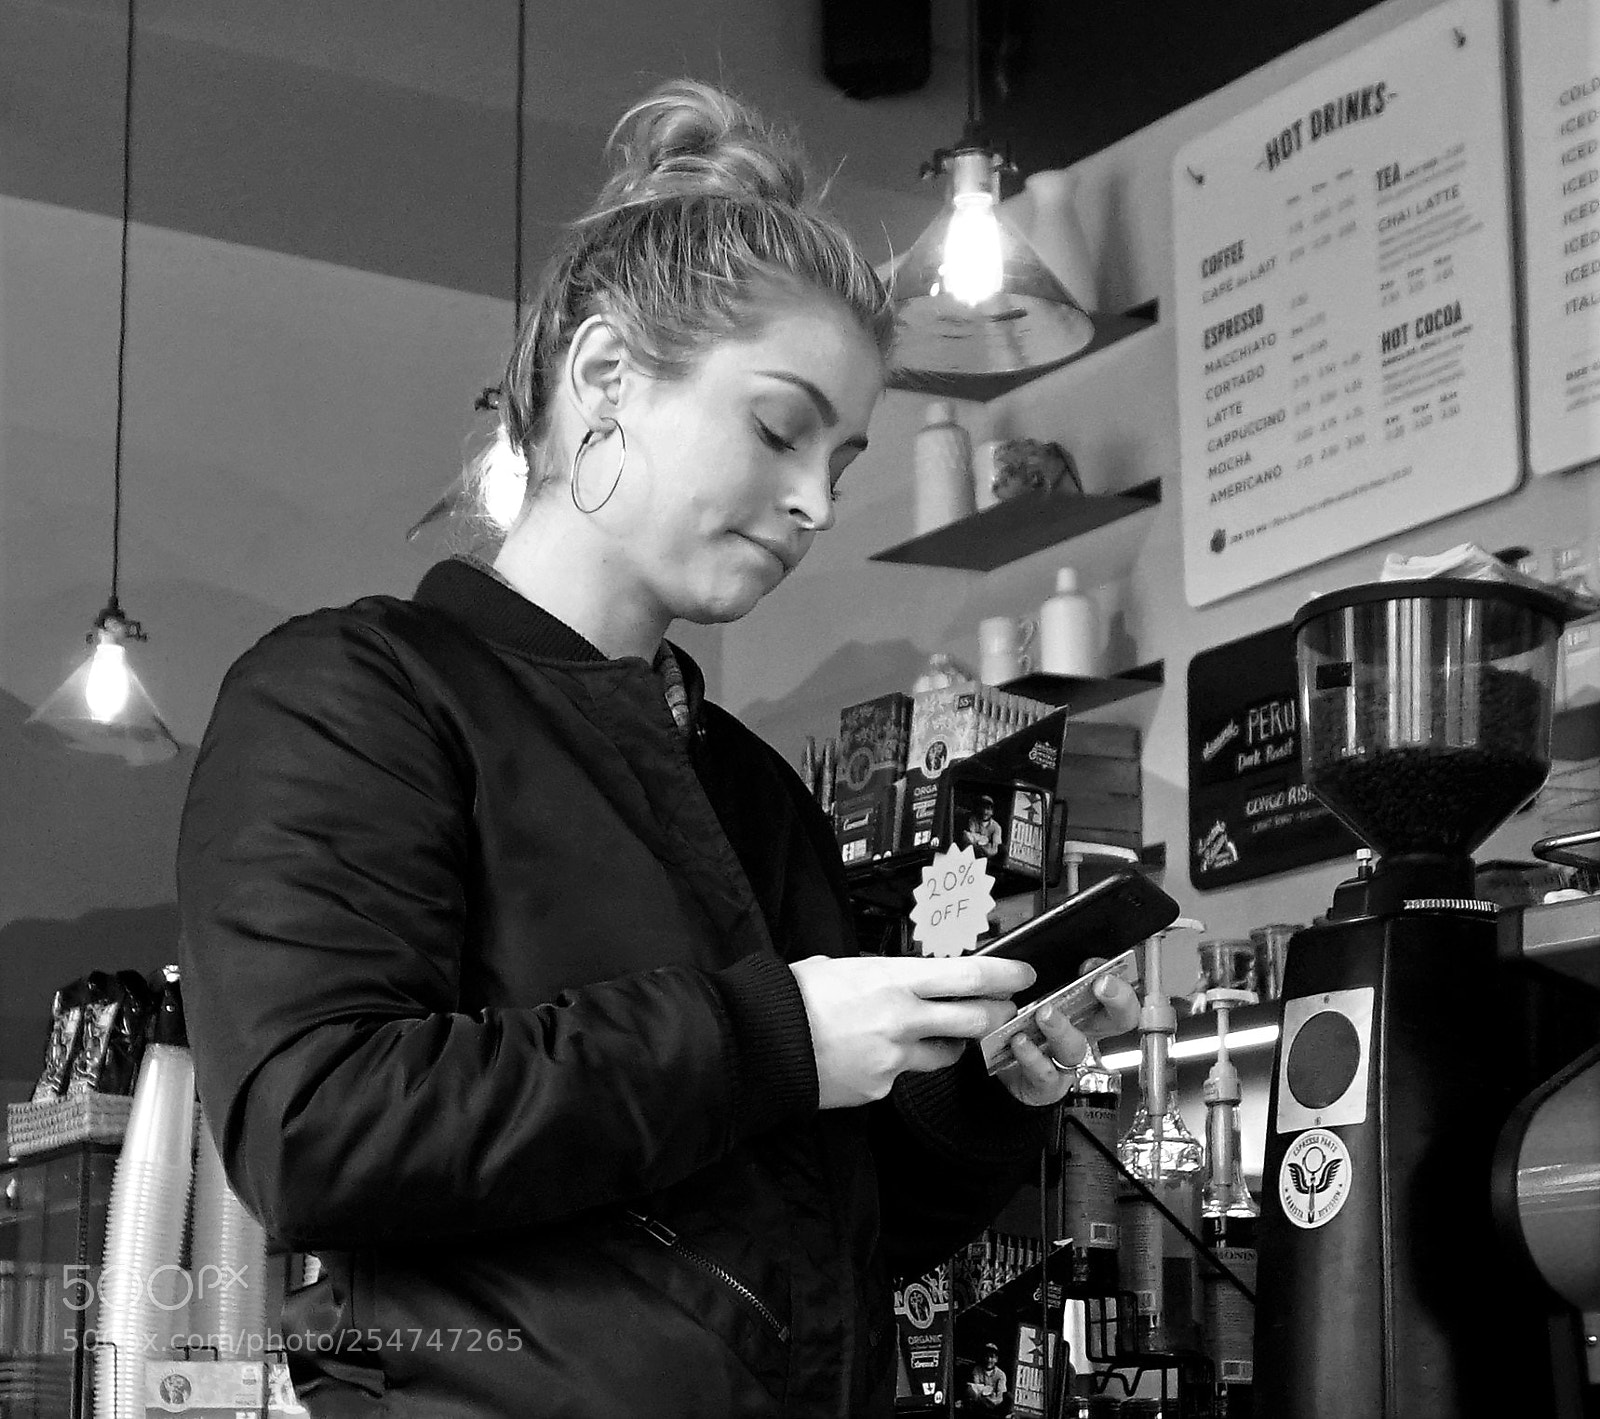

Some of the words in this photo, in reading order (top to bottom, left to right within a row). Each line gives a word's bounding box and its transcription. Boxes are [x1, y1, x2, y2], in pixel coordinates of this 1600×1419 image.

[1265, 119, 1302, 171] HOT
[1309, 81, 1385, 141] DRINKS
[1560, 110, 1597, 136] ICED
[1561, 139, 1598, 165] ICED
[1376, 162, 1401, 191] TEA
[1562, 168, 1599, 195] ICED
[1378, 208, 1411, 232] CHAI
[1416, 184, 1460, 215] LATTE
[1563, 200, 1600, 226] ICED
[1564, 230, 1600, 255] ICED
[1202, 239, 1245, 278] COFFEE
[1204, 304, 1263, 349] ESPRESSO
[1381, 321, 1408, 354] HOT
[1415, 300, 1462, 339] COCOA
[1205, 333, 1276, 375] MACCHIATO
[1206, 365, 1264, 400] CORTADO
[1206, 401, 1243, 428] LATTE
[1207, 408, 1286, 452] CAPPUCCINO
[1208, 451, 1252, 478] MOCHA
[1211, 464, 1282, 503] AMERICANO
[1248, 700, 1295, 745] PERU
[1245, 791, 1285, 816] CONGO
[927, 862, 975, 899] 20%
[931, 898, 970, 926] OFF
[1293, 1136, 1319, 1156] ESPRESSO
[1320, 1137, 1338, 1153] PARTS
[908, 1333, 943, 1345] ORGANIC
